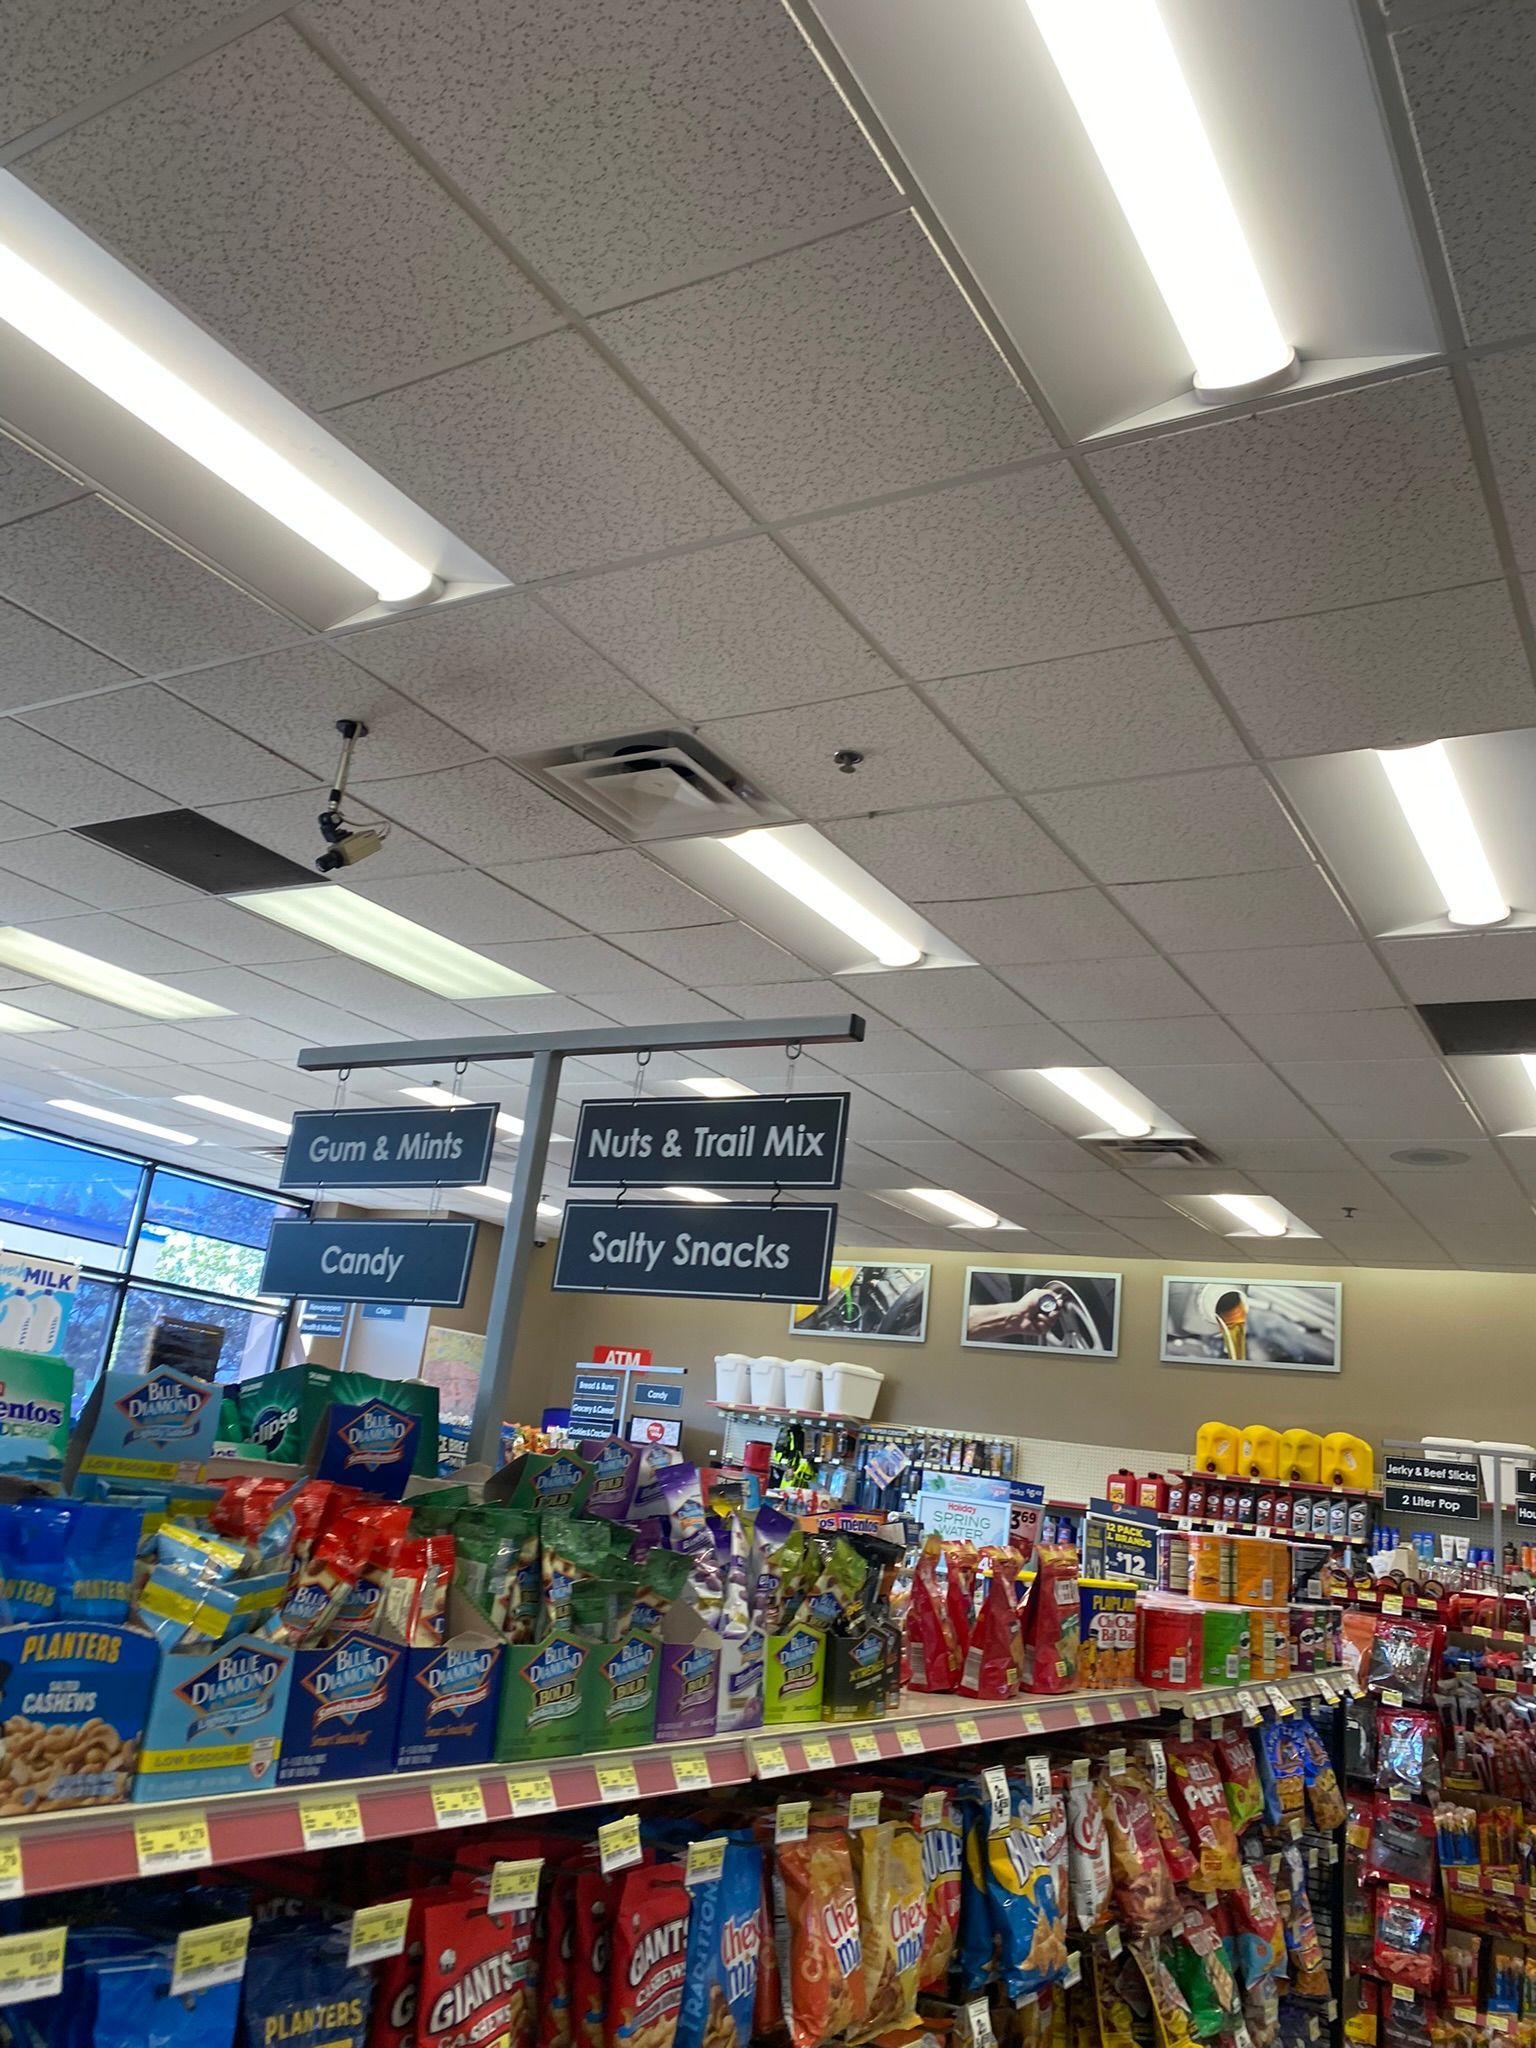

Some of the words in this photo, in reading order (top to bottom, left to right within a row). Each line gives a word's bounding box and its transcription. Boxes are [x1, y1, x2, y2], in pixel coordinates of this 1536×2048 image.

[309, 1135, 366, 1162] Gum
[372, 1135, 389, 1161] &
[396, 1132, 464, 1160] Mints
[588, 1127, 653, 1158] Nuts
[661, 1128, 682, 1157] &
[693, 1125, 755, 1157] Trail
[762, 1124, 825, 1156] Mix
[588, 1230, 666, 1272] Salty
[672, 1232, 790, 1269] Snacks
[321, 1245, 404, 1283] Candy
[24, 1267, 73, 1291] MILK
[605, 1350, 641, 1366] ATM
[148, 1383, 182, 1400] BLUE
[648, 1390, 669, 1401] Candy
[0, 1402, 62, 1424] entos
[128, 1393, 202, 1418] DIAMOND
[349, 1423, 405, 1443] DIAMOND
[364, 1413, 391, 1429] BLUE
[1387, 1464, 1414, 1478] Jerky
[1415, 1467, 1422, 1476] &
[1424, 1467, 1447, 1479] Beef
[1448, 1470, 1477, 1482] Sticks
[947, 1502, 977, 1515] Holiday
[1402, 1495, 1410, 1506] 2
[1412, 1496, 1436, 1508] Liter
[1439, 1498, 1460, 1512] Pop
[841, 1518, 878, 1533] mentos
[933, 1511, 991, 1530] SPRING
[938, 1523, 983, 1541] WATER
[1106, 1522, 1116, 1532] 12
[1117, 1525, 1144, 1538] PACK
[1115, 1534, 1152, 1548] BRANDS
[1116, 1551, 1146, 1576] $12
[20, 1631, 122, 1664] PLANTERS
[545, 1645, 570, 1665] BLUE
[218, 1654, 260, 1682] BLUE
[336, 1647, 371, 1673] BLUE
[429, 1653, 491, 1688] DIAMOND
[530, 1652, 583, 1683] DIAMOND
[609, 1650, 653, 1679] DIAMOND
[192, 1663, 278, 1706] DIAMOND
[315, 1656, 388, 1695] DIAMOND
[22, 1692, 97, 1713] CASHEWS
[539, 1682, 573, 1705] BOLD
[822, 1896, 859, 1945] Che
[890, 1893, 927, 1942] Chex
[430, 1951, 513, 2034] GIANTS
[265, 1999, 363, 2043] PLANTERS
